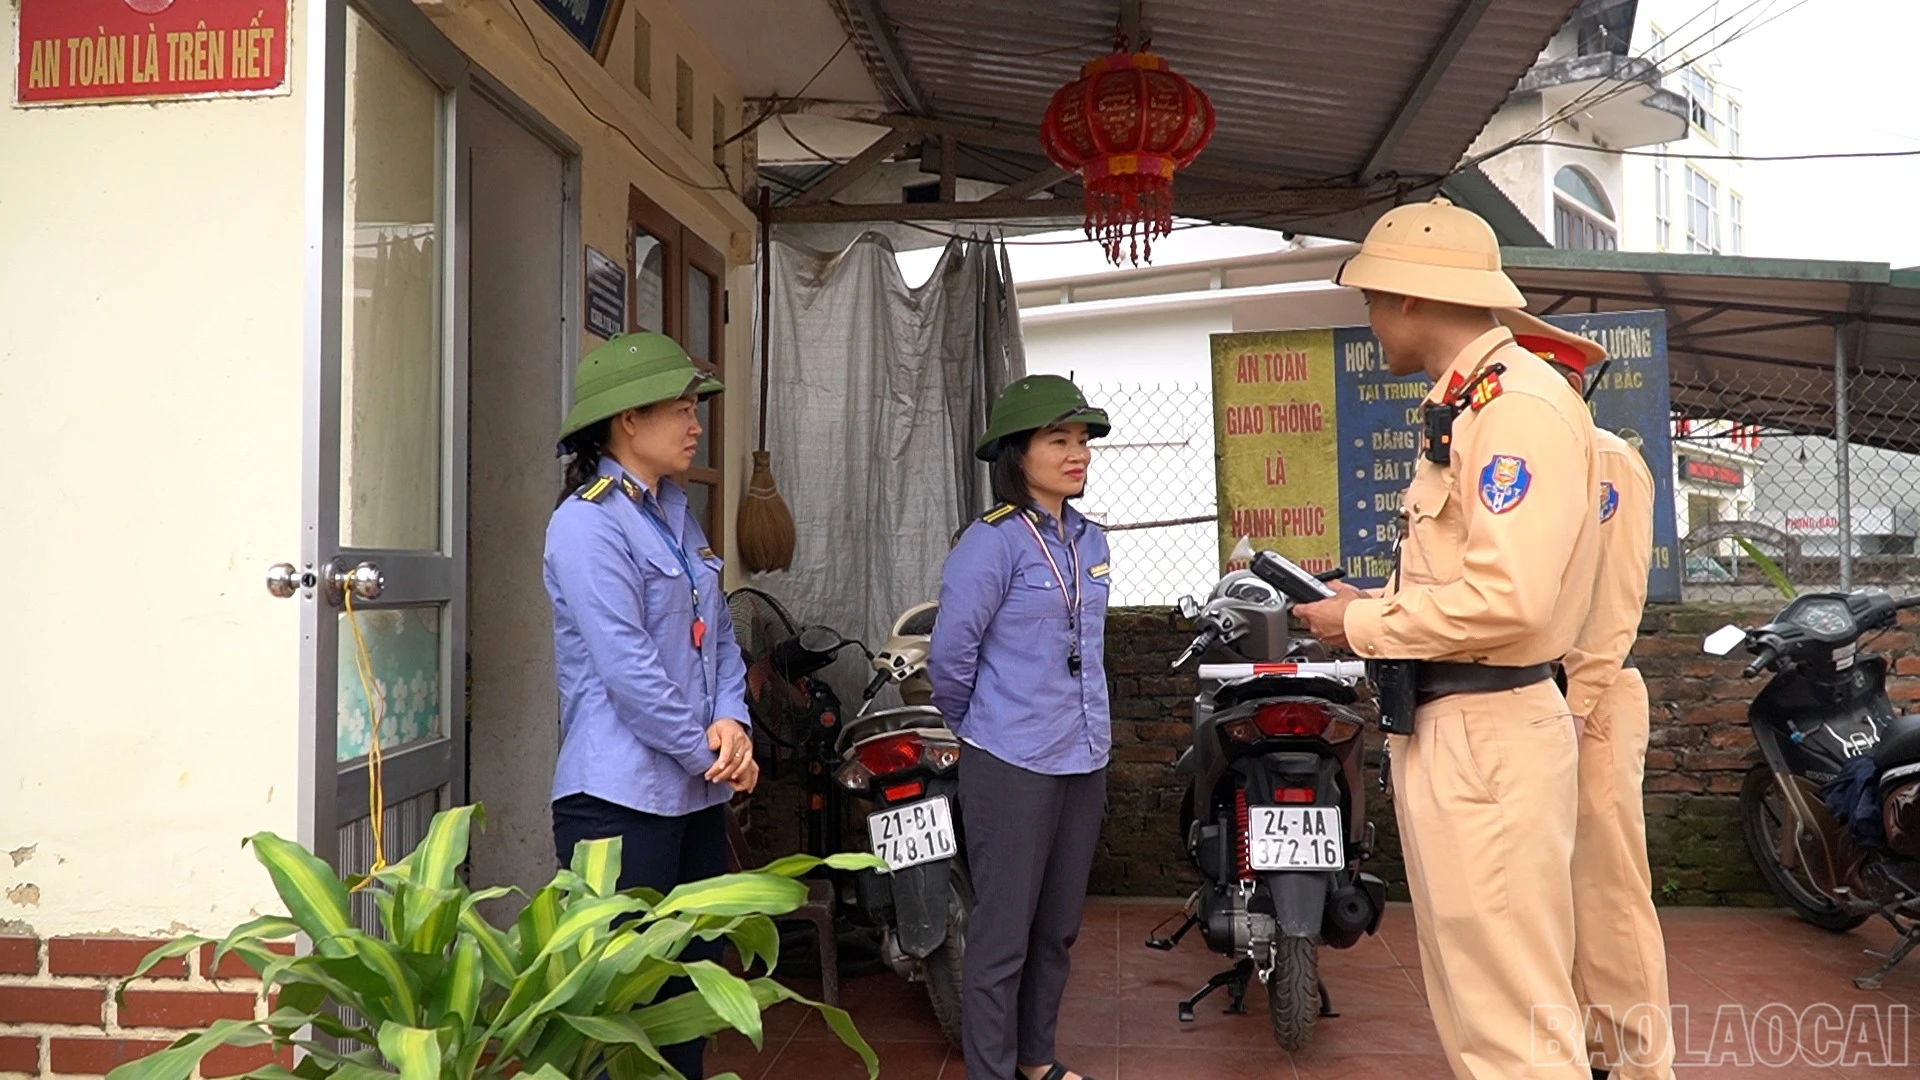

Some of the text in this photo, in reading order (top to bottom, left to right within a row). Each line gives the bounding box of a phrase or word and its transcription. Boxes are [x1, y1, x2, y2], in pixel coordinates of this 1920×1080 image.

[28, 10, 275, 89] AN TOÀN LÀ TRÊN HẾT
[1236, 345, 1308, 384] AN TOÀN
[1345, 341, 1374, 378] HỌC
[1358, 383, 1380, 404] TẠI
[1382, 382, 1428, 400] TRUNG
[1614, 366, 1643, 389] BẮC
[1225, 397, 1323, 436] GIAO THÔNG
[1265, 449, 1287, 485] LÀ
[1280, 501, 1325, 537] PHÚC
[1347, 555, 1362, 578] LH
[1263, 810, 1326, 835] 24-AA
[1258, 838, 1337, 865] 372.16
